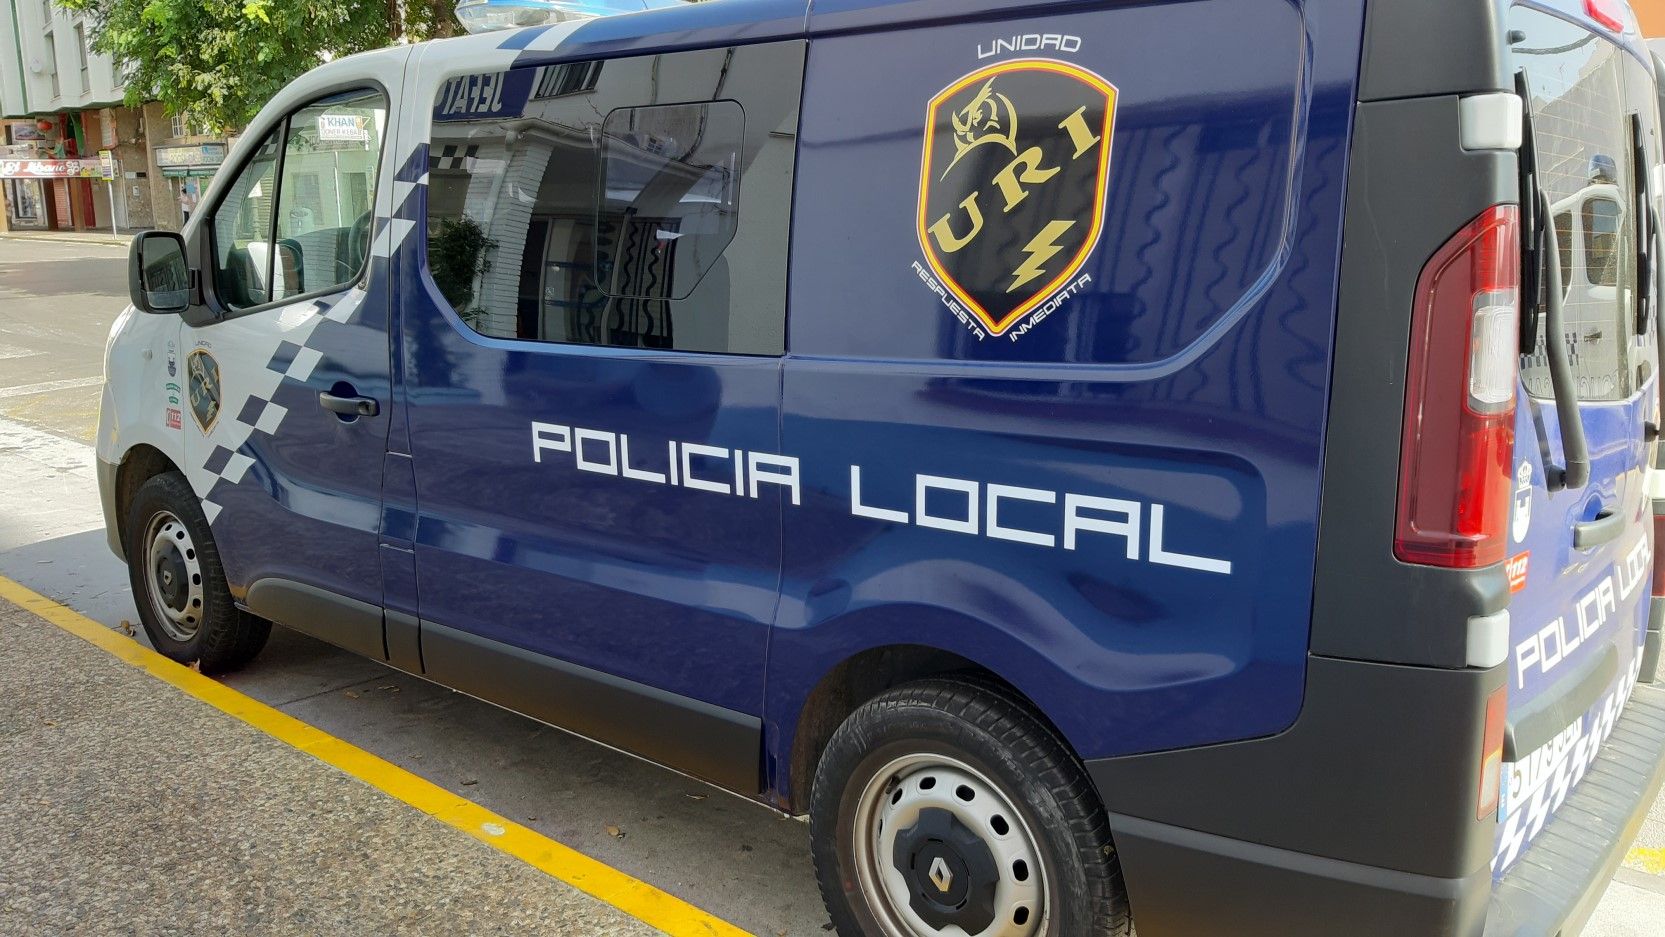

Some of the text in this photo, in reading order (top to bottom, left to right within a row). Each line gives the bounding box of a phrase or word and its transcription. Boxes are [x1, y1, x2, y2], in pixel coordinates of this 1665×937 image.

[977, 33, 1082, 59] UNIDAD
[328, 117, 355, 127] KHAN
[927, 105, 1102, 254] URI
[911, 260, 986, 342] RESPUESTA
[1009, 272, 1092, 343] INMEDIATA
[532, 421, 1232, 575] POLICIA LOCAL
[1516, 532, 1652, 690] POLICIA LOCAL
